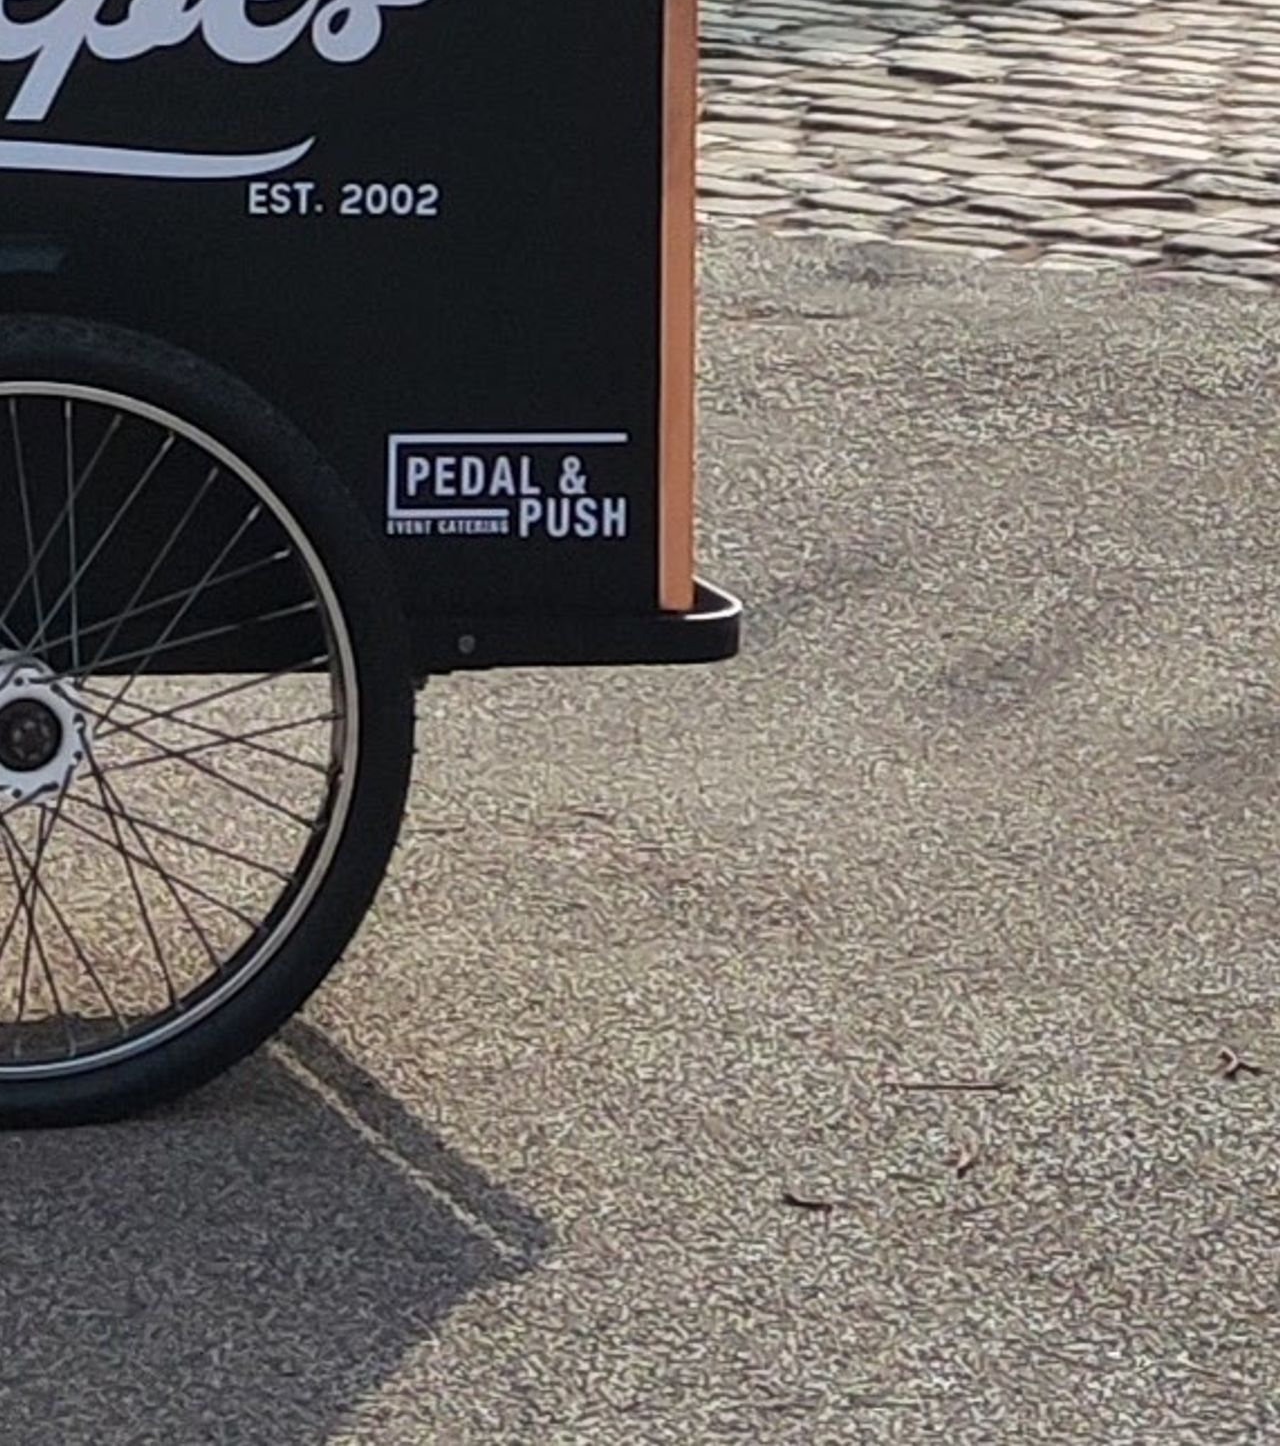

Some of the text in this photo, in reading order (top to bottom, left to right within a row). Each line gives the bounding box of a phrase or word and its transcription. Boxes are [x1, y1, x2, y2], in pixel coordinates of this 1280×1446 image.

[248, 182, 439, 217] EST. 2002
[406, 456, 588, 496] PEDAL &
[386, 520, 509, 534] EVENT CATERING
[519, 497, 627, 537] PUSH
